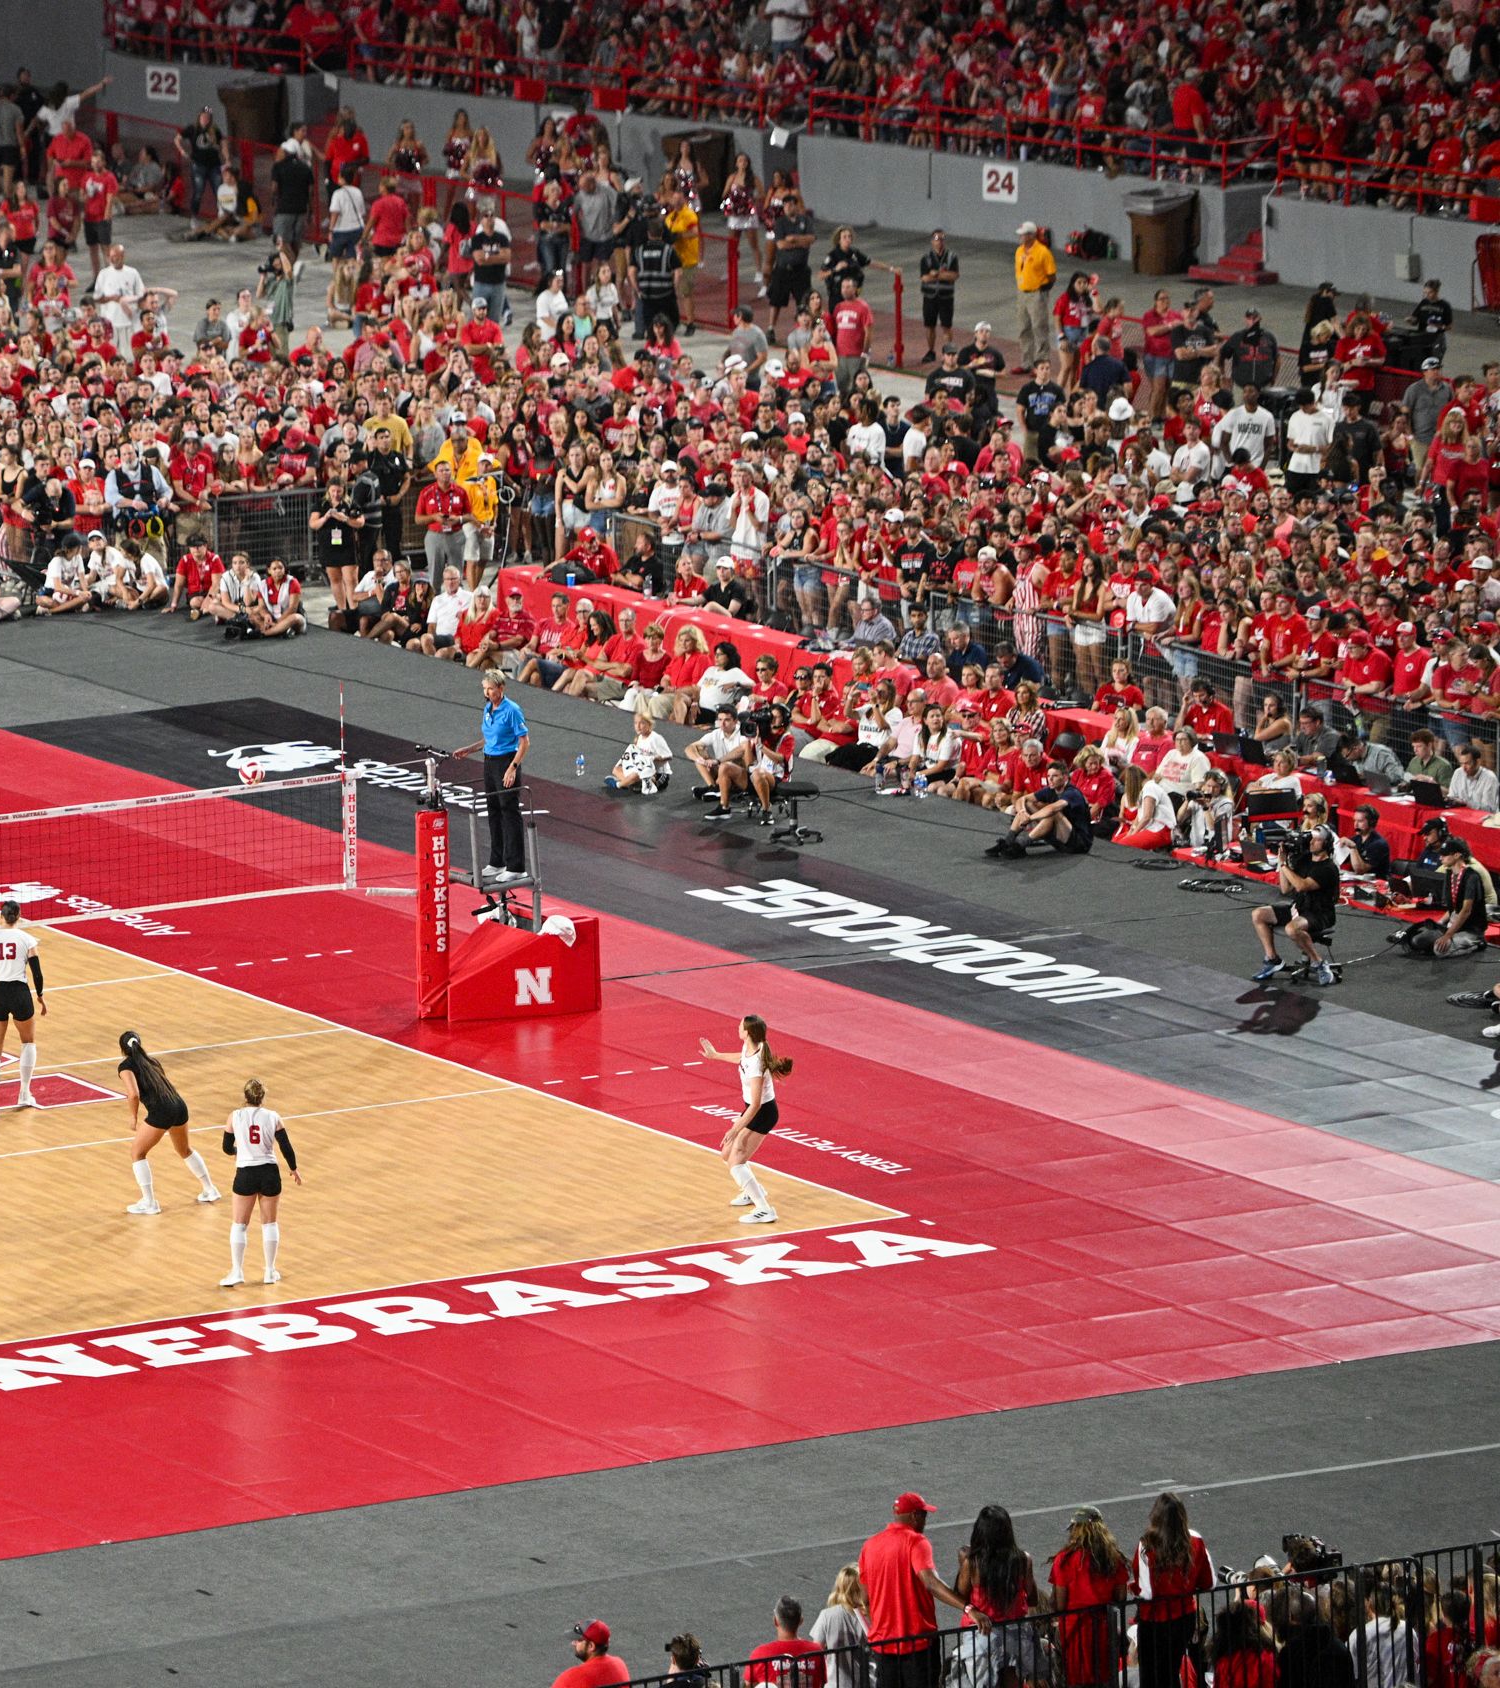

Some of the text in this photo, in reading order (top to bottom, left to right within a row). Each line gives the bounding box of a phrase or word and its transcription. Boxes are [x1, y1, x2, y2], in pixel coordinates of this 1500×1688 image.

[150, 71, 177, 95] 22
[987, 170, 1015, 194] 24
[348, 793, 357, 868] HUSKERS
[431, 835, 447, 954] HUSKERS
[684, 879, 1161, 1004] WOODHOUSE
[514, 966, 554, 1006] N
[249, 1124, 261, 1144] 6
[835, 1145, 912, 1175] TERRY
